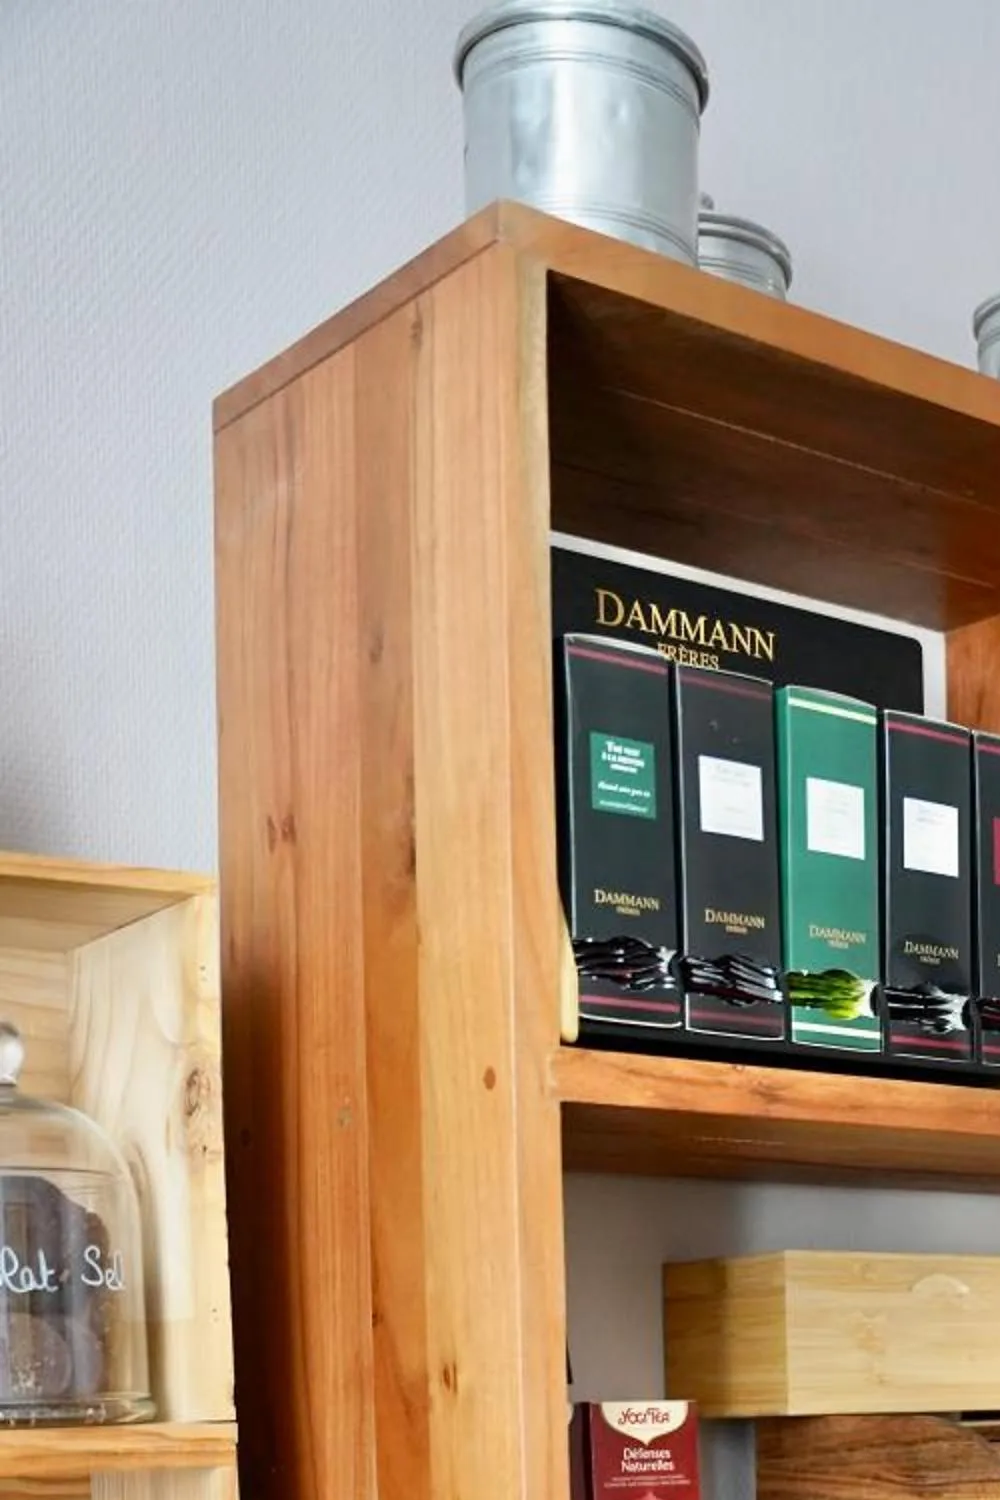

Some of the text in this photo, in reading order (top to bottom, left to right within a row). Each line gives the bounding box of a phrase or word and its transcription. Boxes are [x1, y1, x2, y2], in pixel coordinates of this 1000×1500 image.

[594, 588, 776, 661] DAMMANN
[658, 643, 719, 670] FRÈRES
[594, 889, 660, 911] DAMMANN
[704, 908, 765, 929] DAMMANN
[808, 924, 867, 944] DAMMANN
[904, 940, 959, 960] DAMMANN
[0, 1244, 125, 1294] lat Sel
